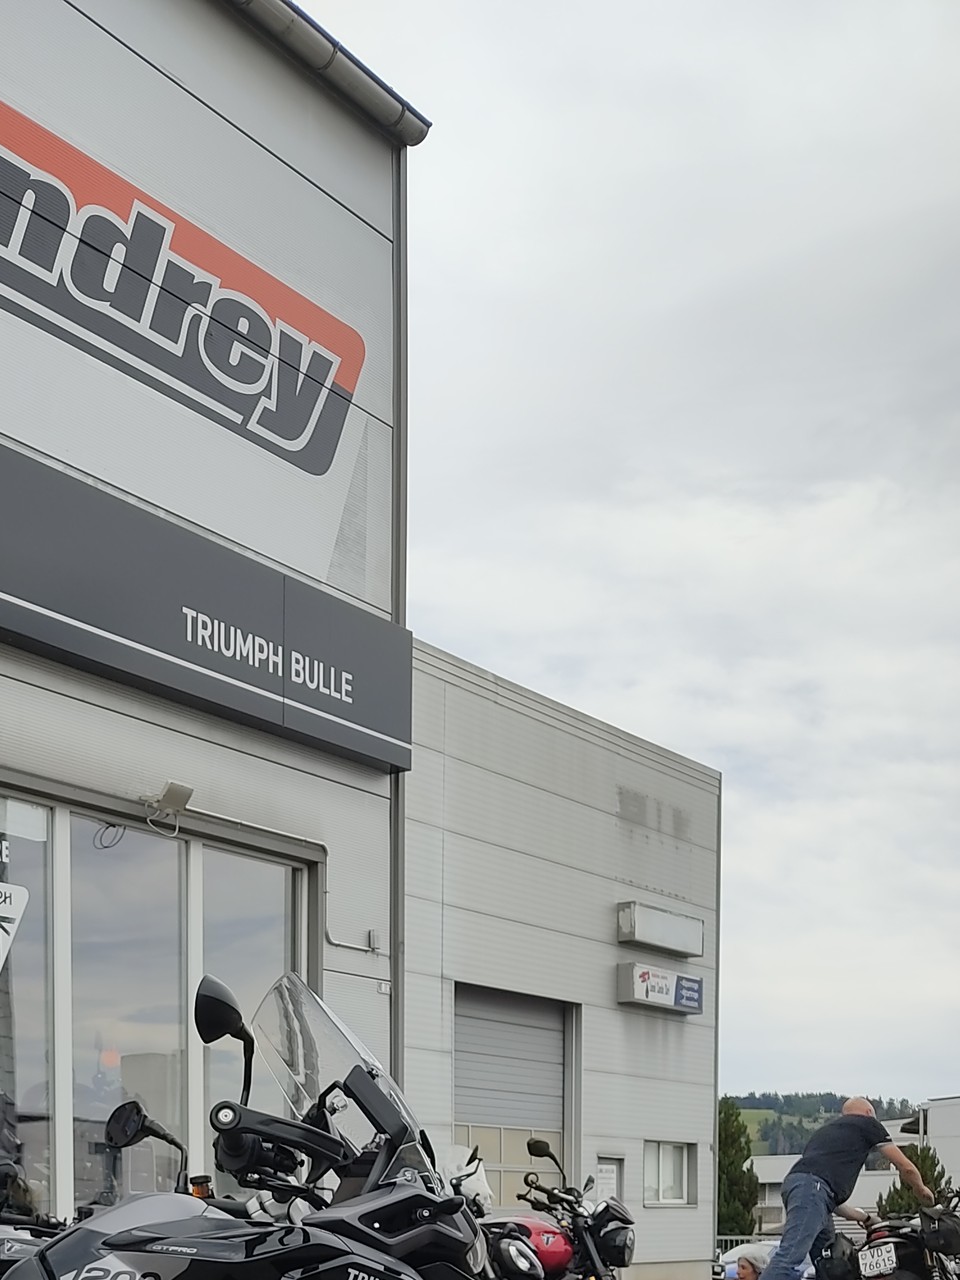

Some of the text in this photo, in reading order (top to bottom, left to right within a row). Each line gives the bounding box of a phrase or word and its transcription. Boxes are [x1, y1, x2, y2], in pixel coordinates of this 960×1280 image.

[182, 606, 353, 704] TRIUMPH BULLE
[869, 1247, 883, 1259] VD
[861, 1256, 894, 1272] 76615
